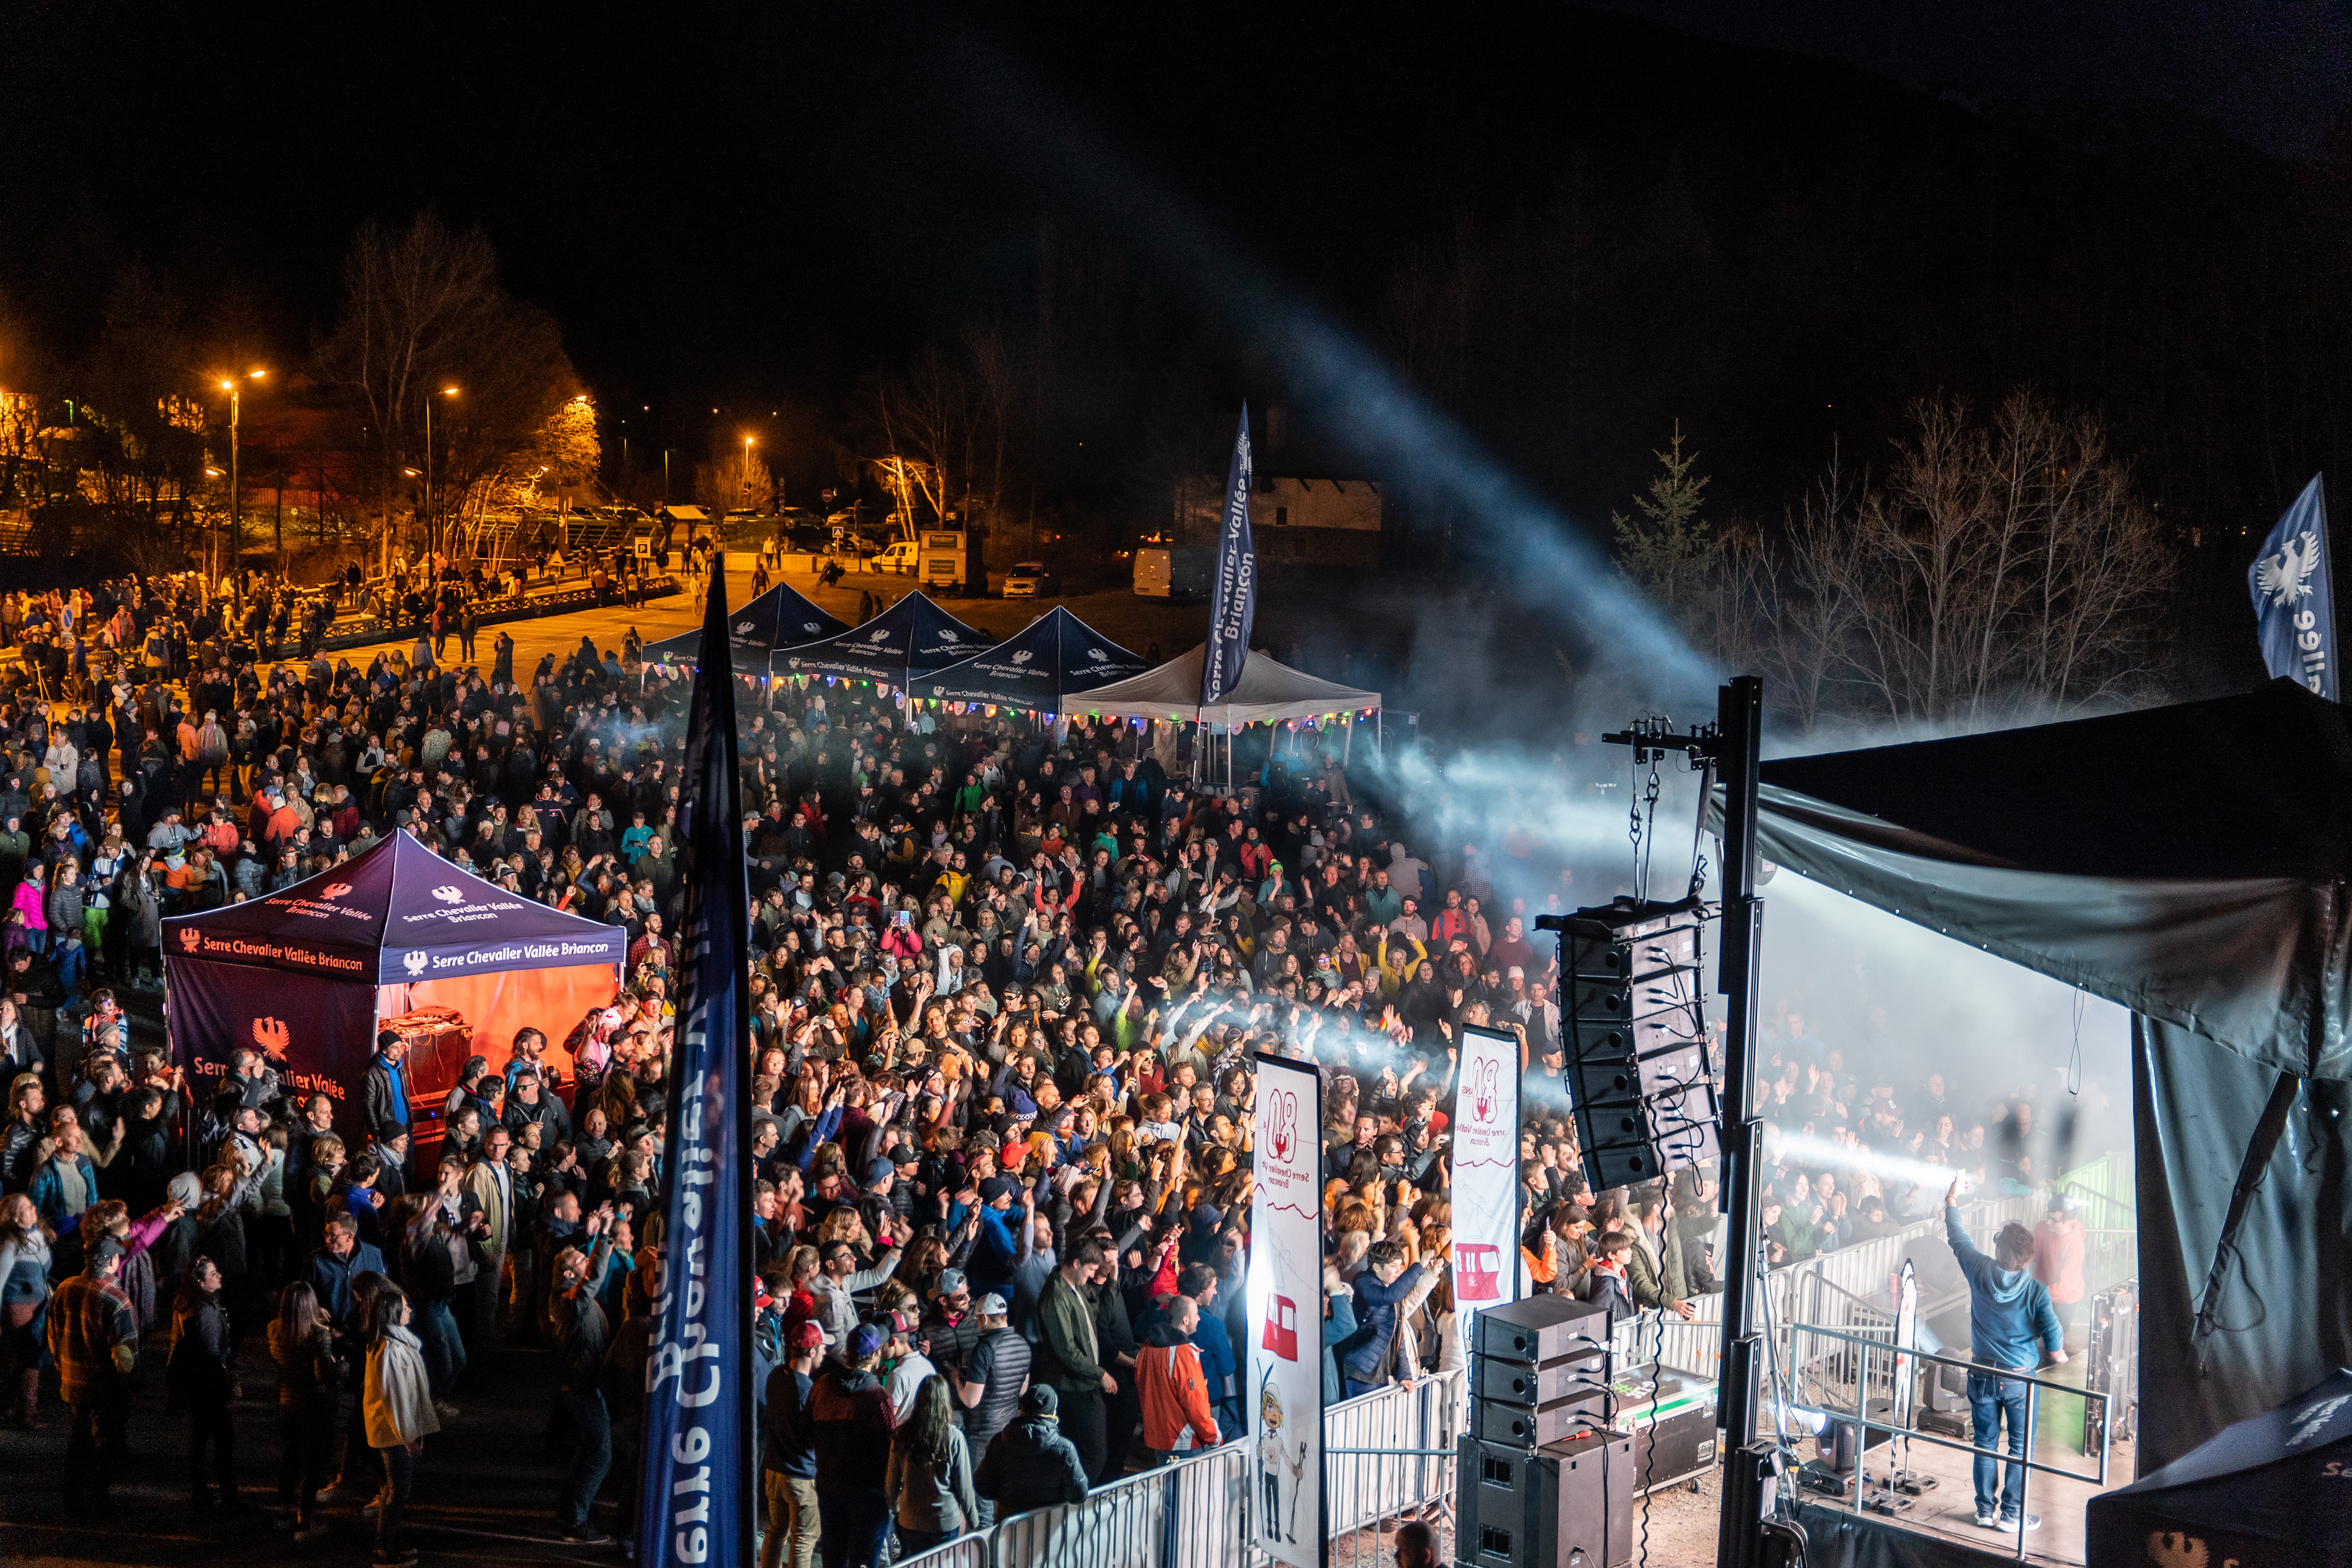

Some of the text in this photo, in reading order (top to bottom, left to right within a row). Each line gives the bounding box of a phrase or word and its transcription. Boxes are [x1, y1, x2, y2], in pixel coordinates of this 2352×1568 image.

[1224, 552, 1254, 640] Briançon
[801, 661, 816, 669] Serre
[816, 661, 848, 672] Chevalier
[971, 661, 992, 670] Serre
[991, 663, 1028, 674] Chevalier
[961, 690, 990, 700] Chevalier
[265, 898, 372, 921] Serre Chevalier Vallée
[403, 901, 524, 923] Serre Chevalier Vallée
[204, 937, 363, 971] Serre Chevalier Vallée Briançon
[432, 942, 609, 969] Serre Chevalier Vallée Briançon
[194, 1056, 229, 1076] Serr
[277, 1069, 310, 1089] alier
